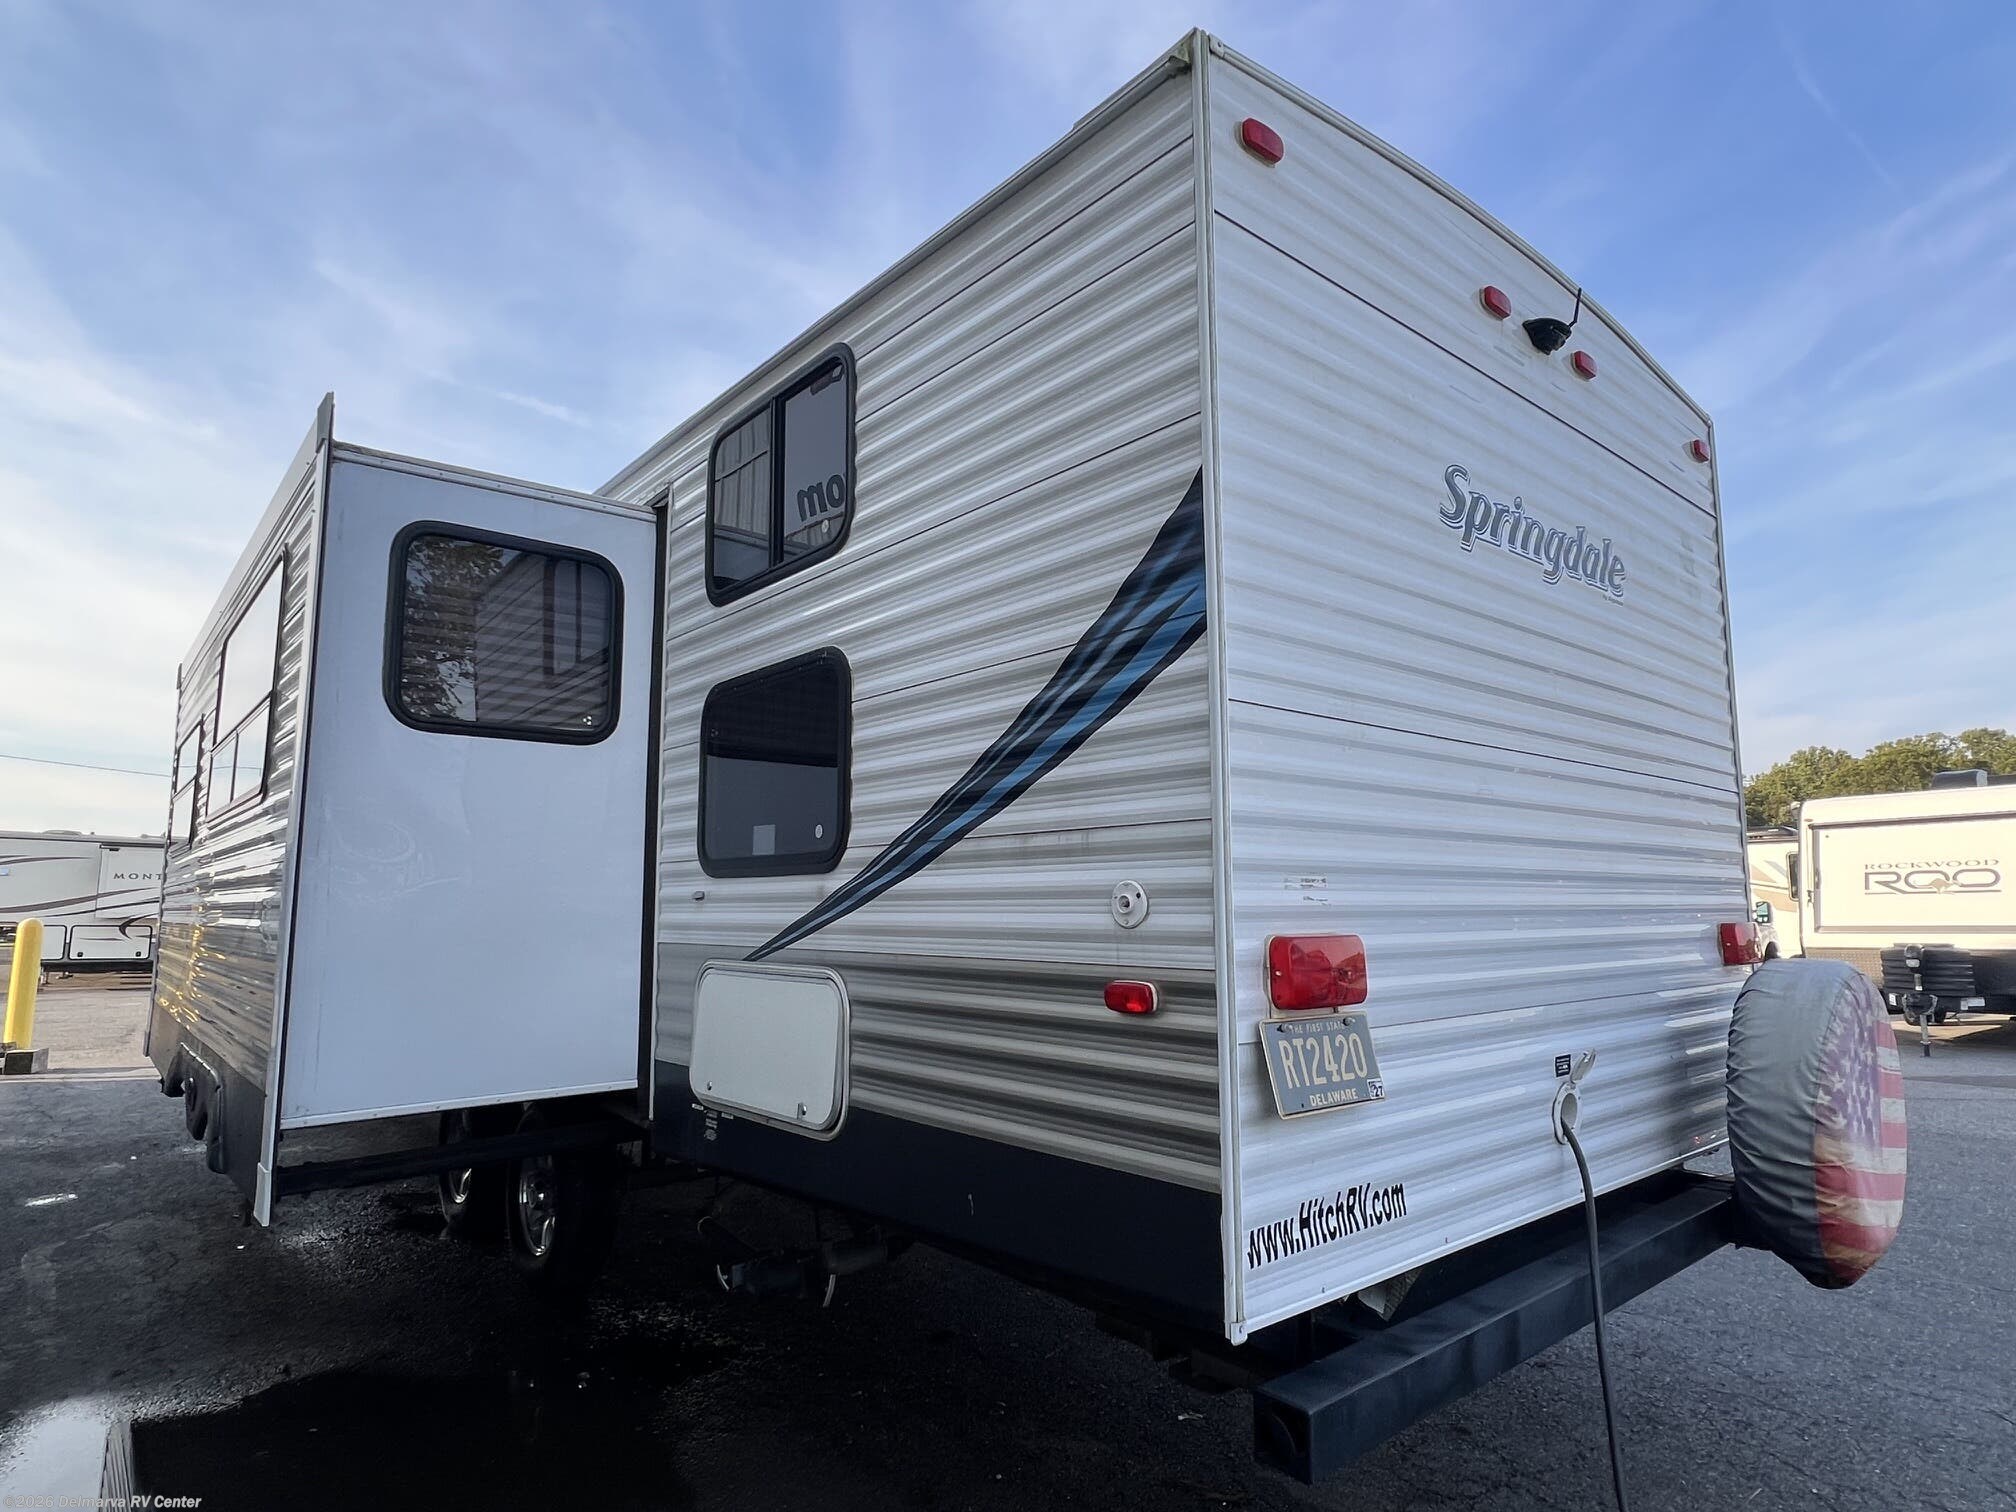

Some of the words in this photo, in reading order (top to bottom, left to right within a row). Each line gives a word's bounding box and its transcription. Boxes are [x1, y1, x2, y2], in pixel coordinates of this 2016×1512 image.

[1439, 464, 1627, 597] Springdale
[1864, 858, 2000, 870] ROCKWOOD
[113, 872, 163, 880] MONT
[1864, 868, 2002, 894] ROO
[1306, 1022, 1323, 1034] FIRST
[1278, 1032, 1368, 1089] RT2420
[1309, 1087, 1359, 1107] DELAWARE
[1246, 1182, 1407, 1269] www.HitchRV.com
